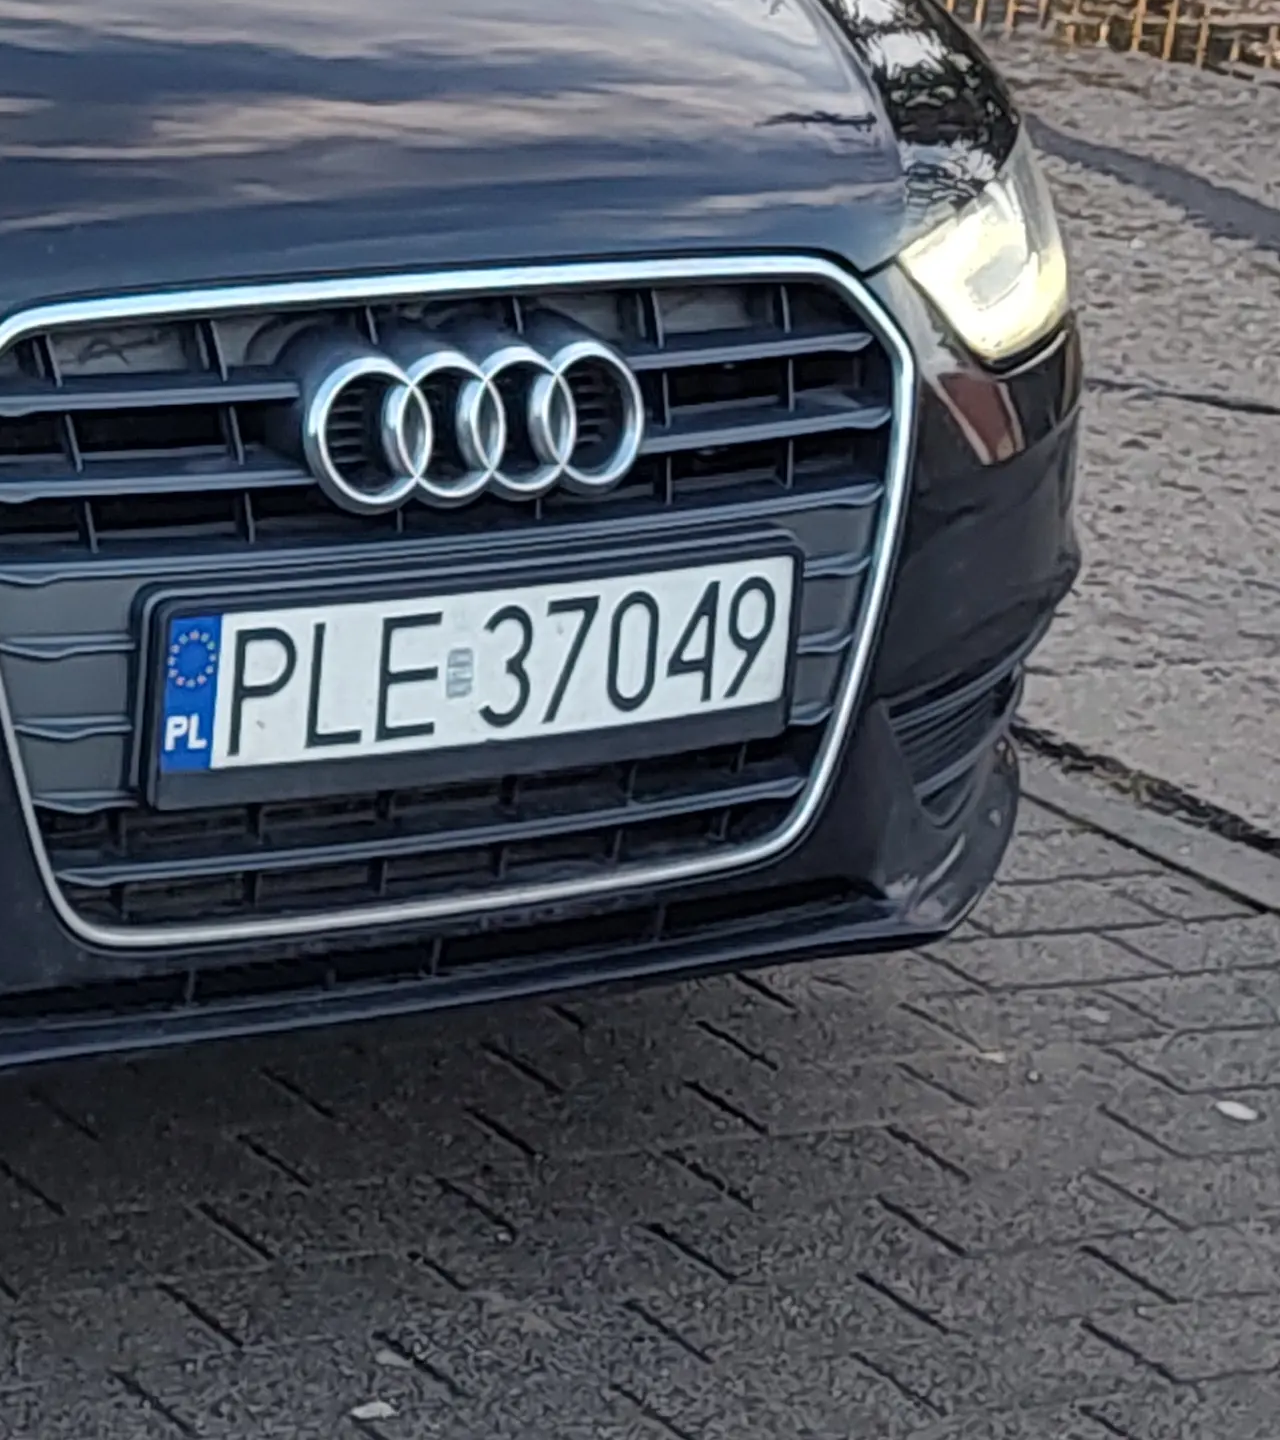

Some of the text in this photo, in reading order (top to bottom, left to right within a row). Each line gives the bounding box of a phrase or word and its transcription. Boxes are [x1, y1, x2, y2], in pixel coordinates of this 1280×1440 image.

[226, 575, 777, 757] PLE 37049
[164, 714, 208, 752] PL
